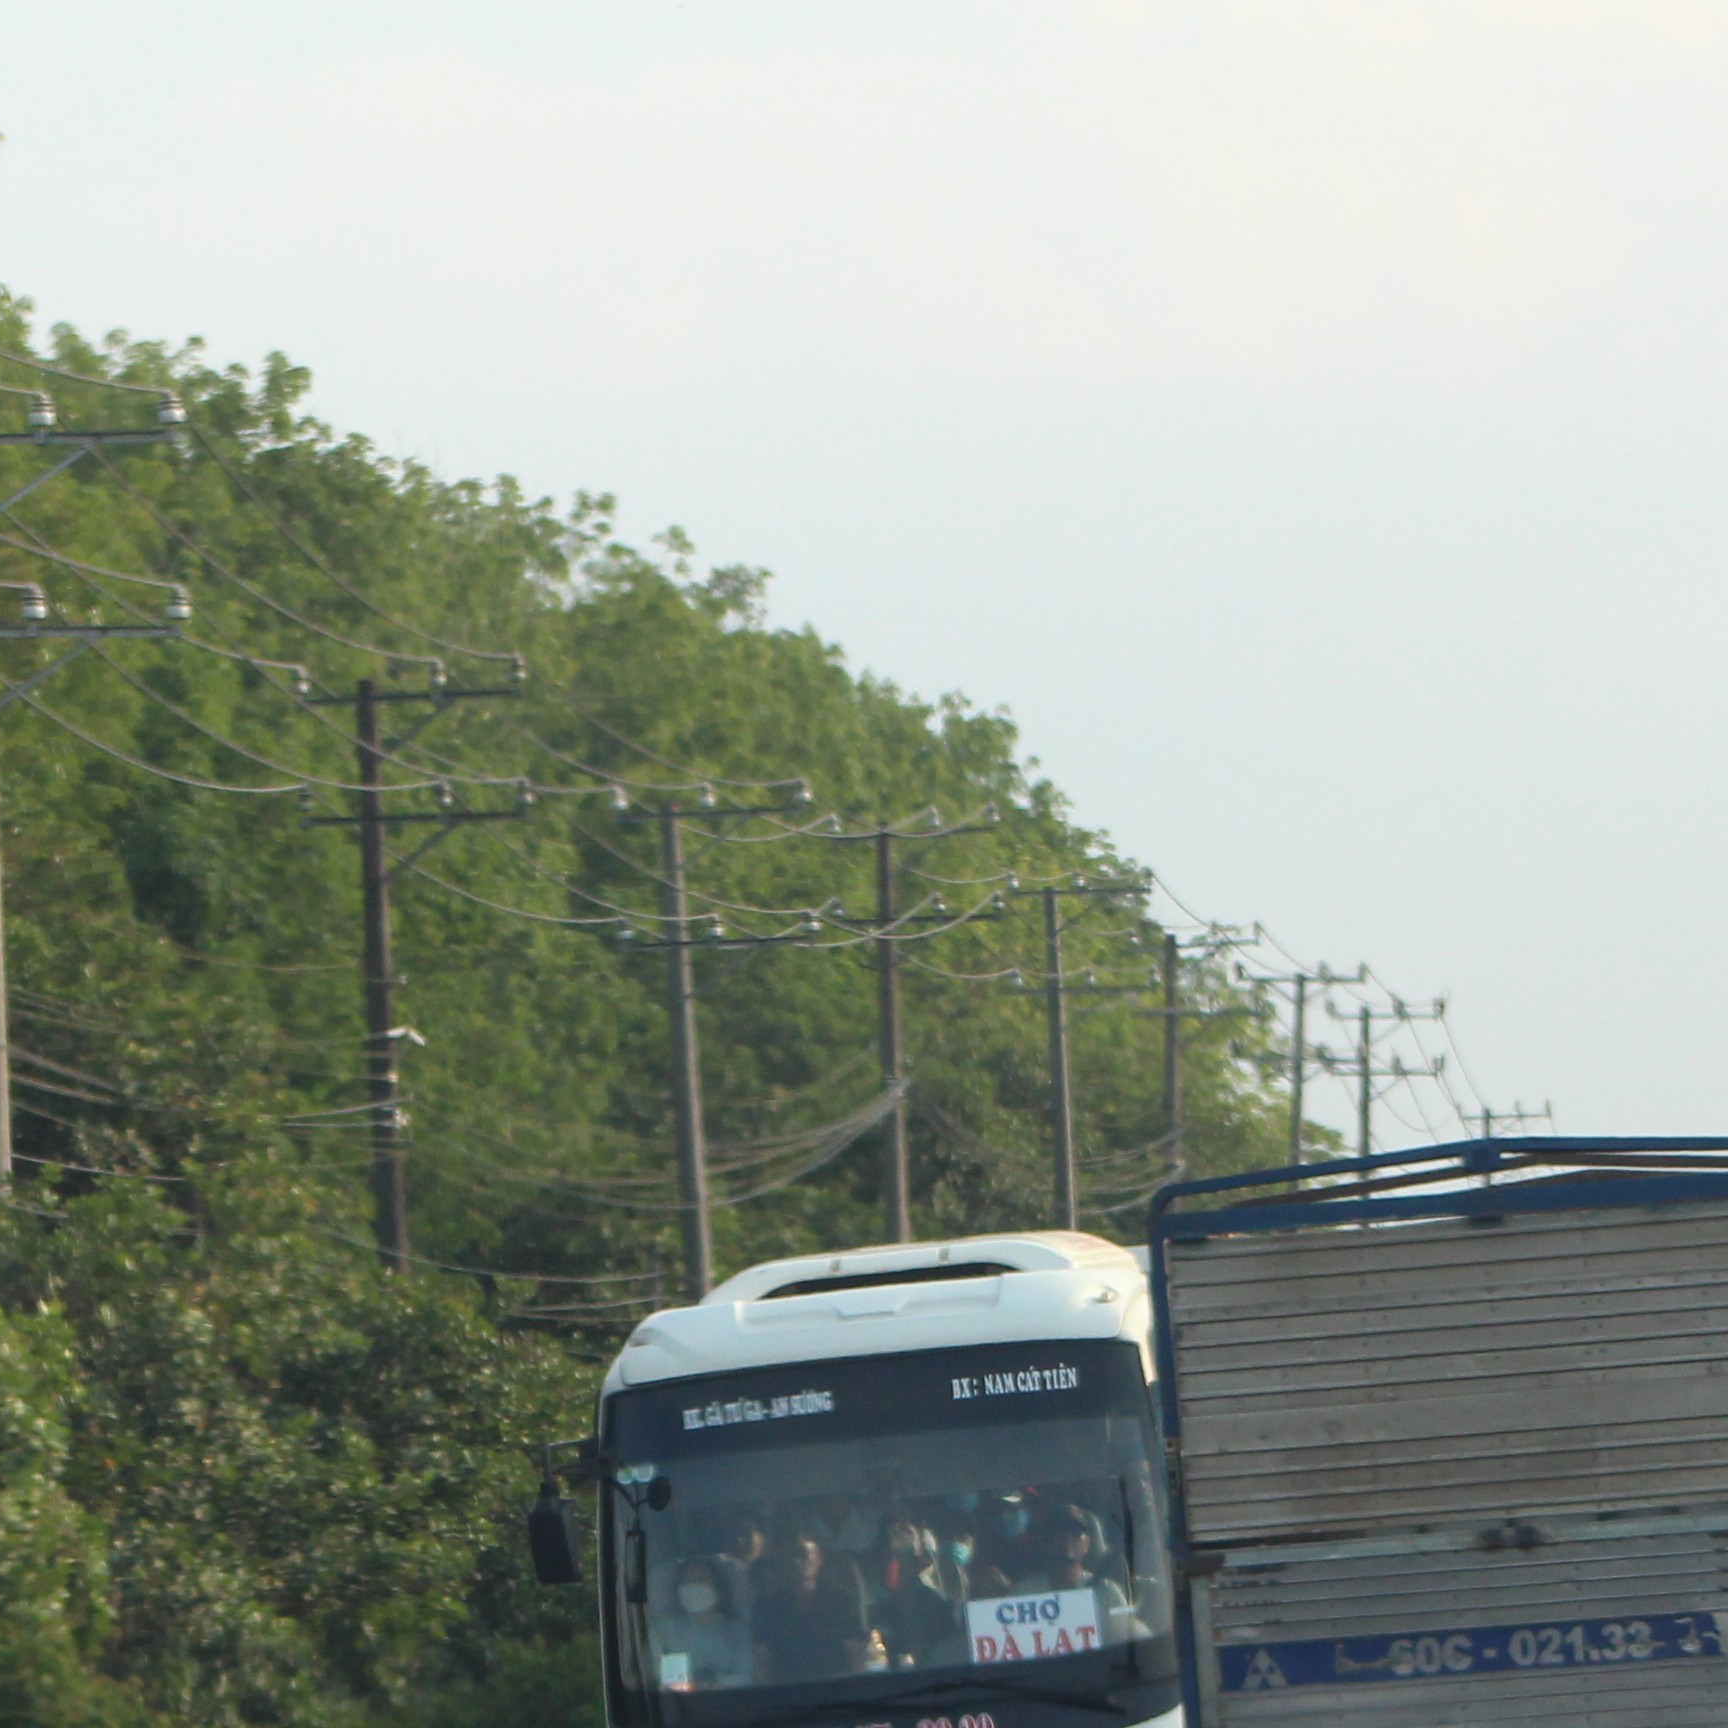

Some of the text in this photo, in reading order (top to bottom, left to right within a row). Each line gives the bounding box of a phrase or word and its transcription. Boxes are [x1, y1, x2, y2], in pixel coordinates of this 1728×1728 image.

[983, 1372, 1016, 1395] NAM
[995, 1593, 1060, 1626] CHỢ
[1387, 1634, 1474, 1676] 60C
[1508, 1619, 1654, 1667] 021.33
